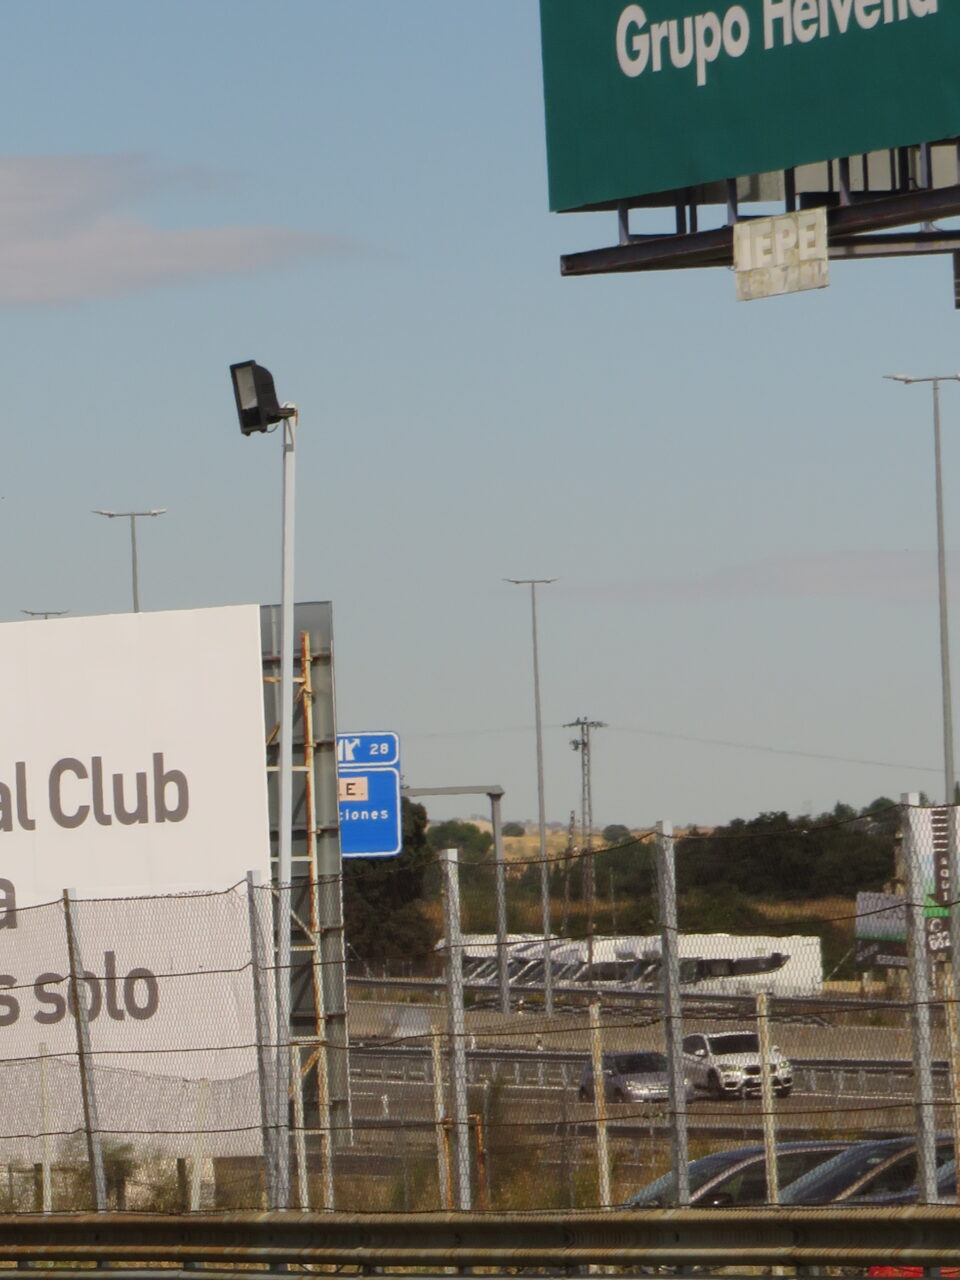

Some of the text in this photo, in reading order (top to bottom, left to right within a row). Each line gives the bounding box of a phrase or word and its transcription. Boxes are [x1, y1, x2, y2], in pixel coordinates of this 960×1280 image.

[616, 4, 749, 86] Grupo
[369, 743, 389, 755] 28
[48, 752, 189, 829] Club
[33, 951, 158, 1024] solo
